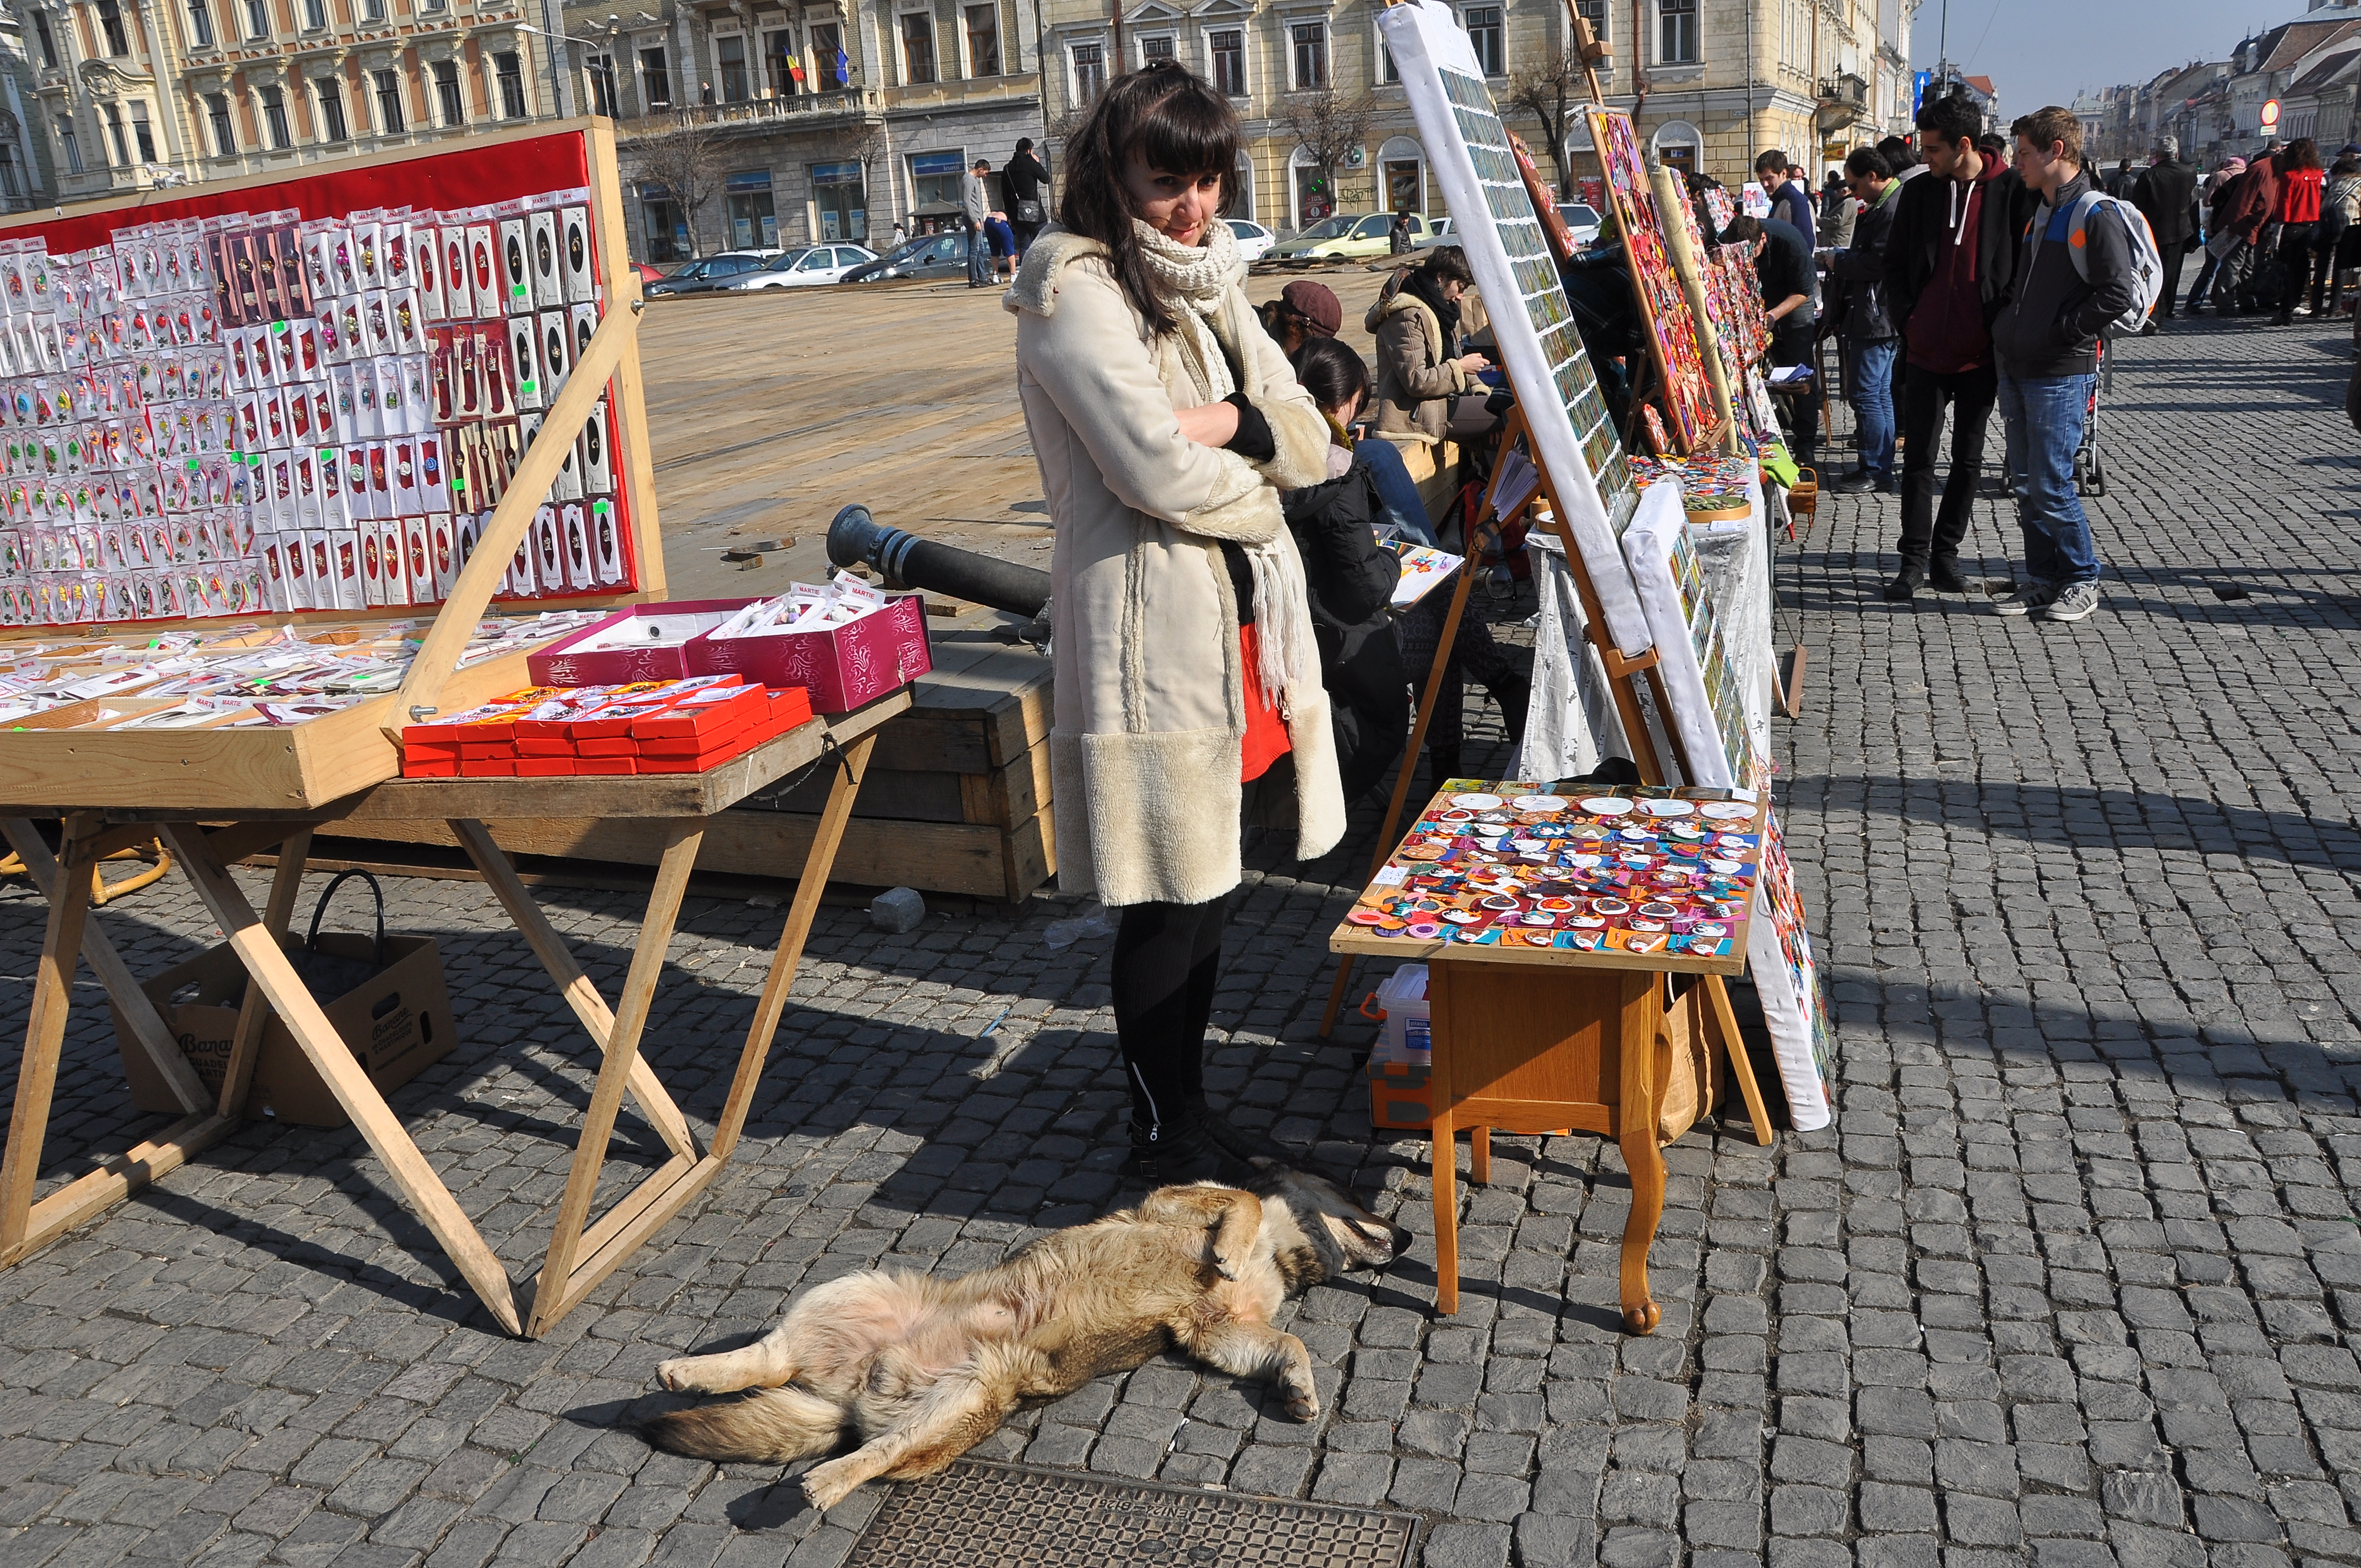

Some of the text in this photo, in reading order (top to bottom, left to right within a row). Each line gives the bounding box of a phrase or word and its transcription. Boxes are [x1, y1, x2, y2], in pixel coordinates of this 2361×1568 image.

[387, 210, 405, 219] MARTIE
[412, 212, 427, 220] MARTIE
[799, 587, 820, 595] MARTIE
[852, 587, 875, 599] MARTIE
[765, 598, 782, 607] MARTIE
